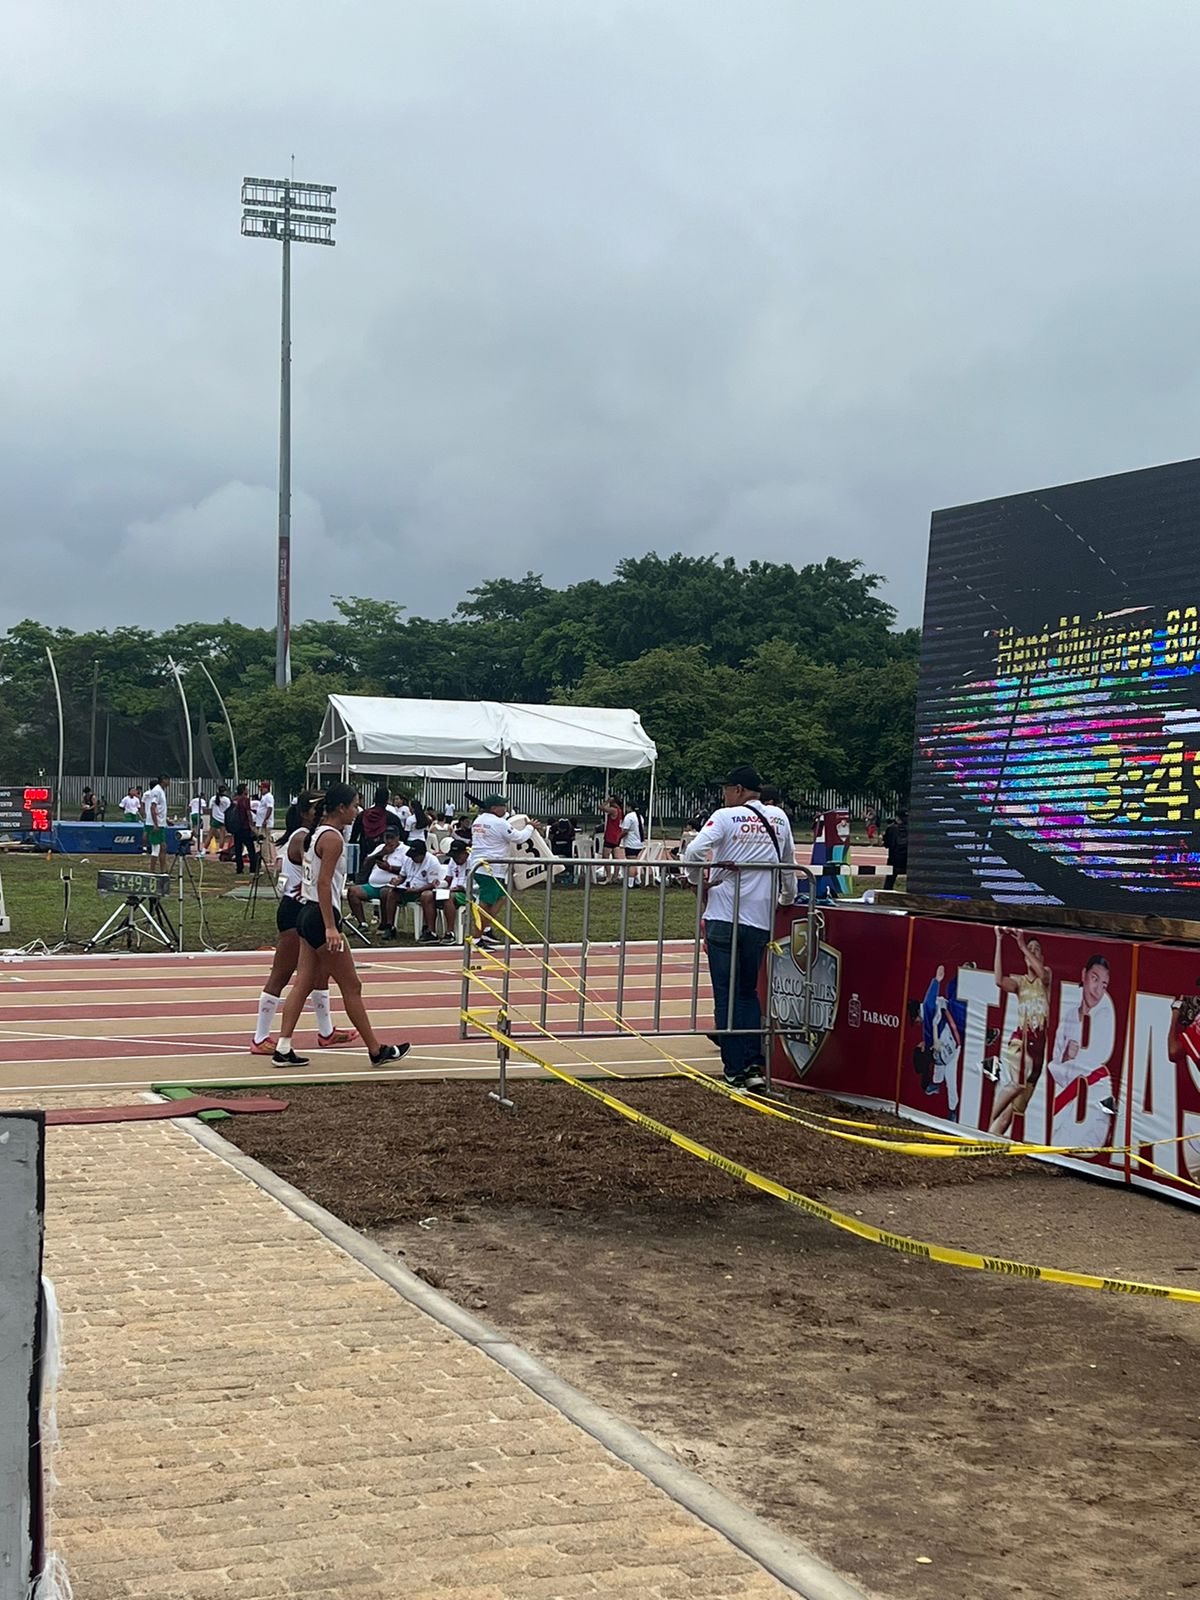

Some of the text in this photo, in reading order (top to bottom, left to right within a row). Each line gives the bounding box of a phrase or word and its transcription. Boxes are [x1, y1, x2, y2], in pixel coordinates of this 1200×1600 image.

[1086, 740, 1200, 821] 3:4
[24, 800, 31, 809] 2
[731, 815, 763, 824] TABAS
[741, 823, 780, 836] OFICL
[113, 835, 136, 844] GILL
[771, 976, 837, 1002] ACIOLES
[770, 995, 835, 1030] CONDE
[862, 1009, 900, 1028] TABASCO
[956, 966, 1200, 1188] TABA
